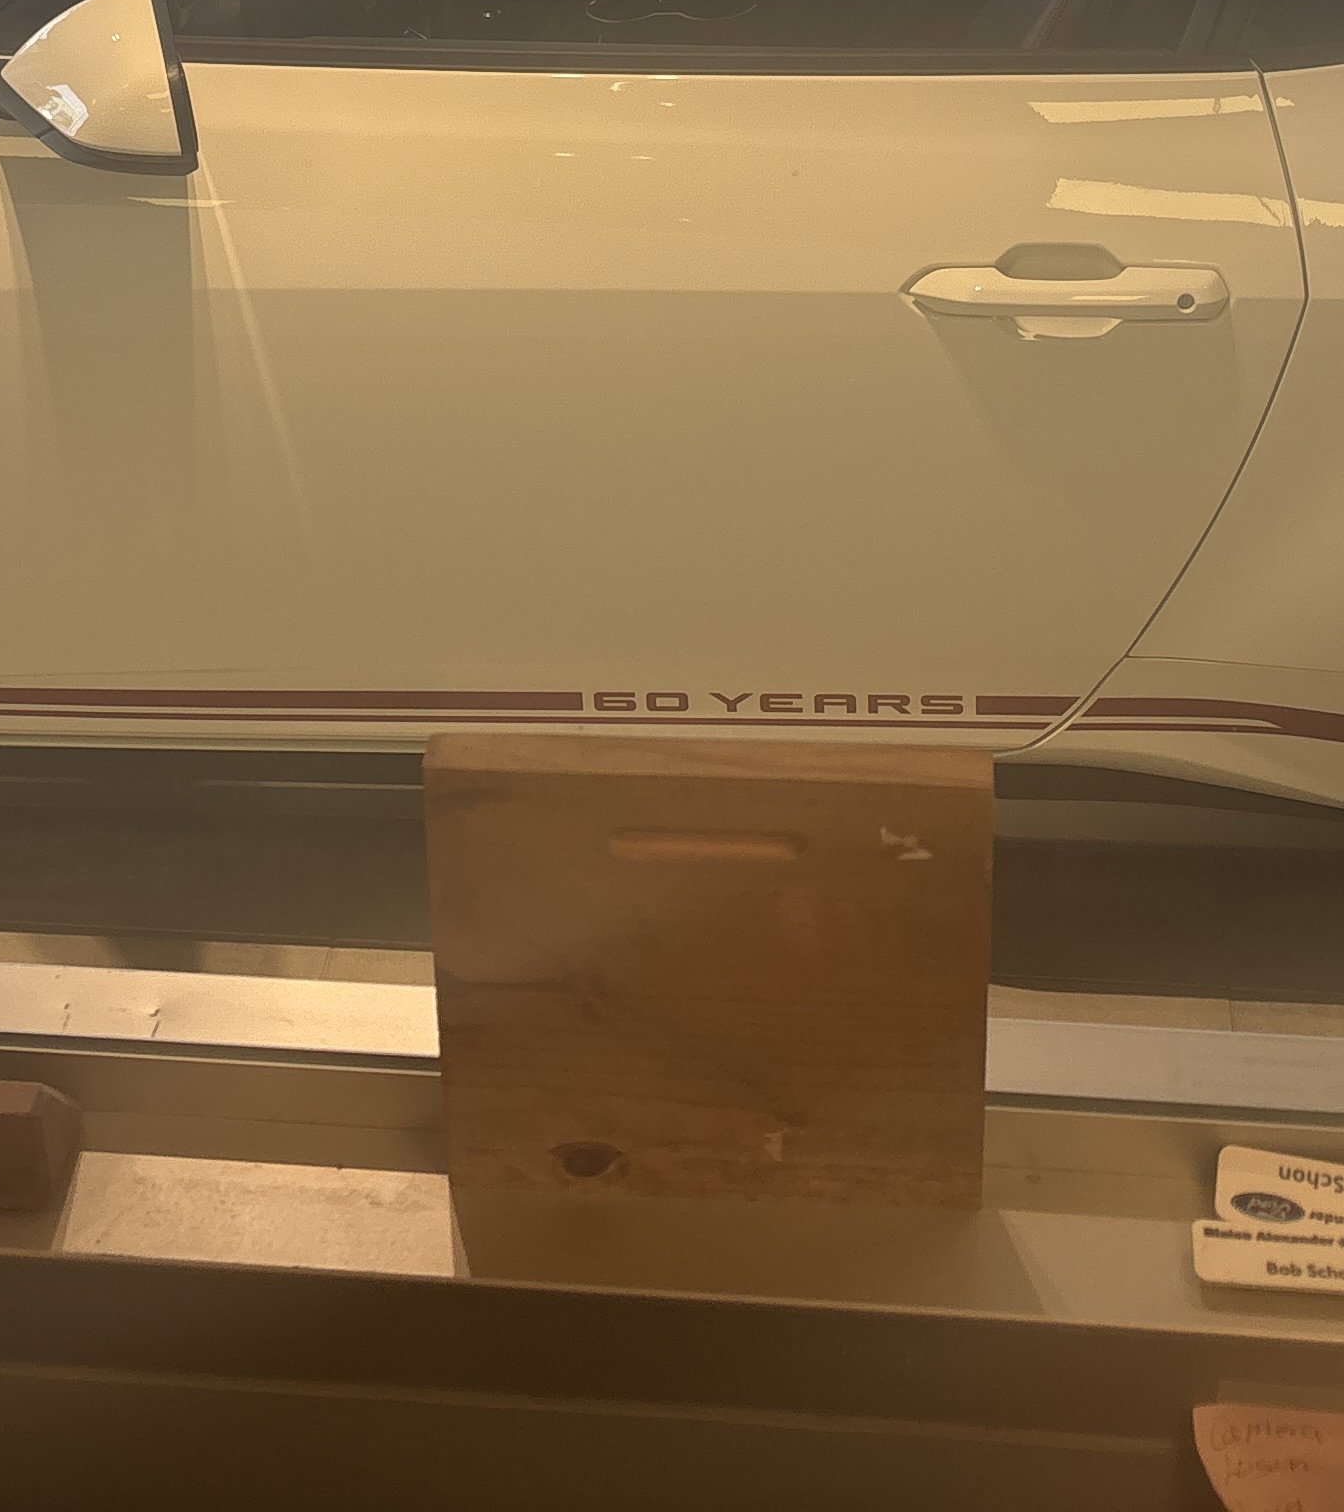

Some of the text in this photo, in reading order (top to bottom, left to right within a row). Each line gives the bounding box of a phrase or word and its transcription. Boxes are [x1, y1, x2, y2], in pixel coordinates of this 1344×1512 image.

[592, 691, 964, 716] 60 YEARS
[1278, 1165, 1344, 1194] Schon
[1266, 1261, 1303, 1279] Bob
